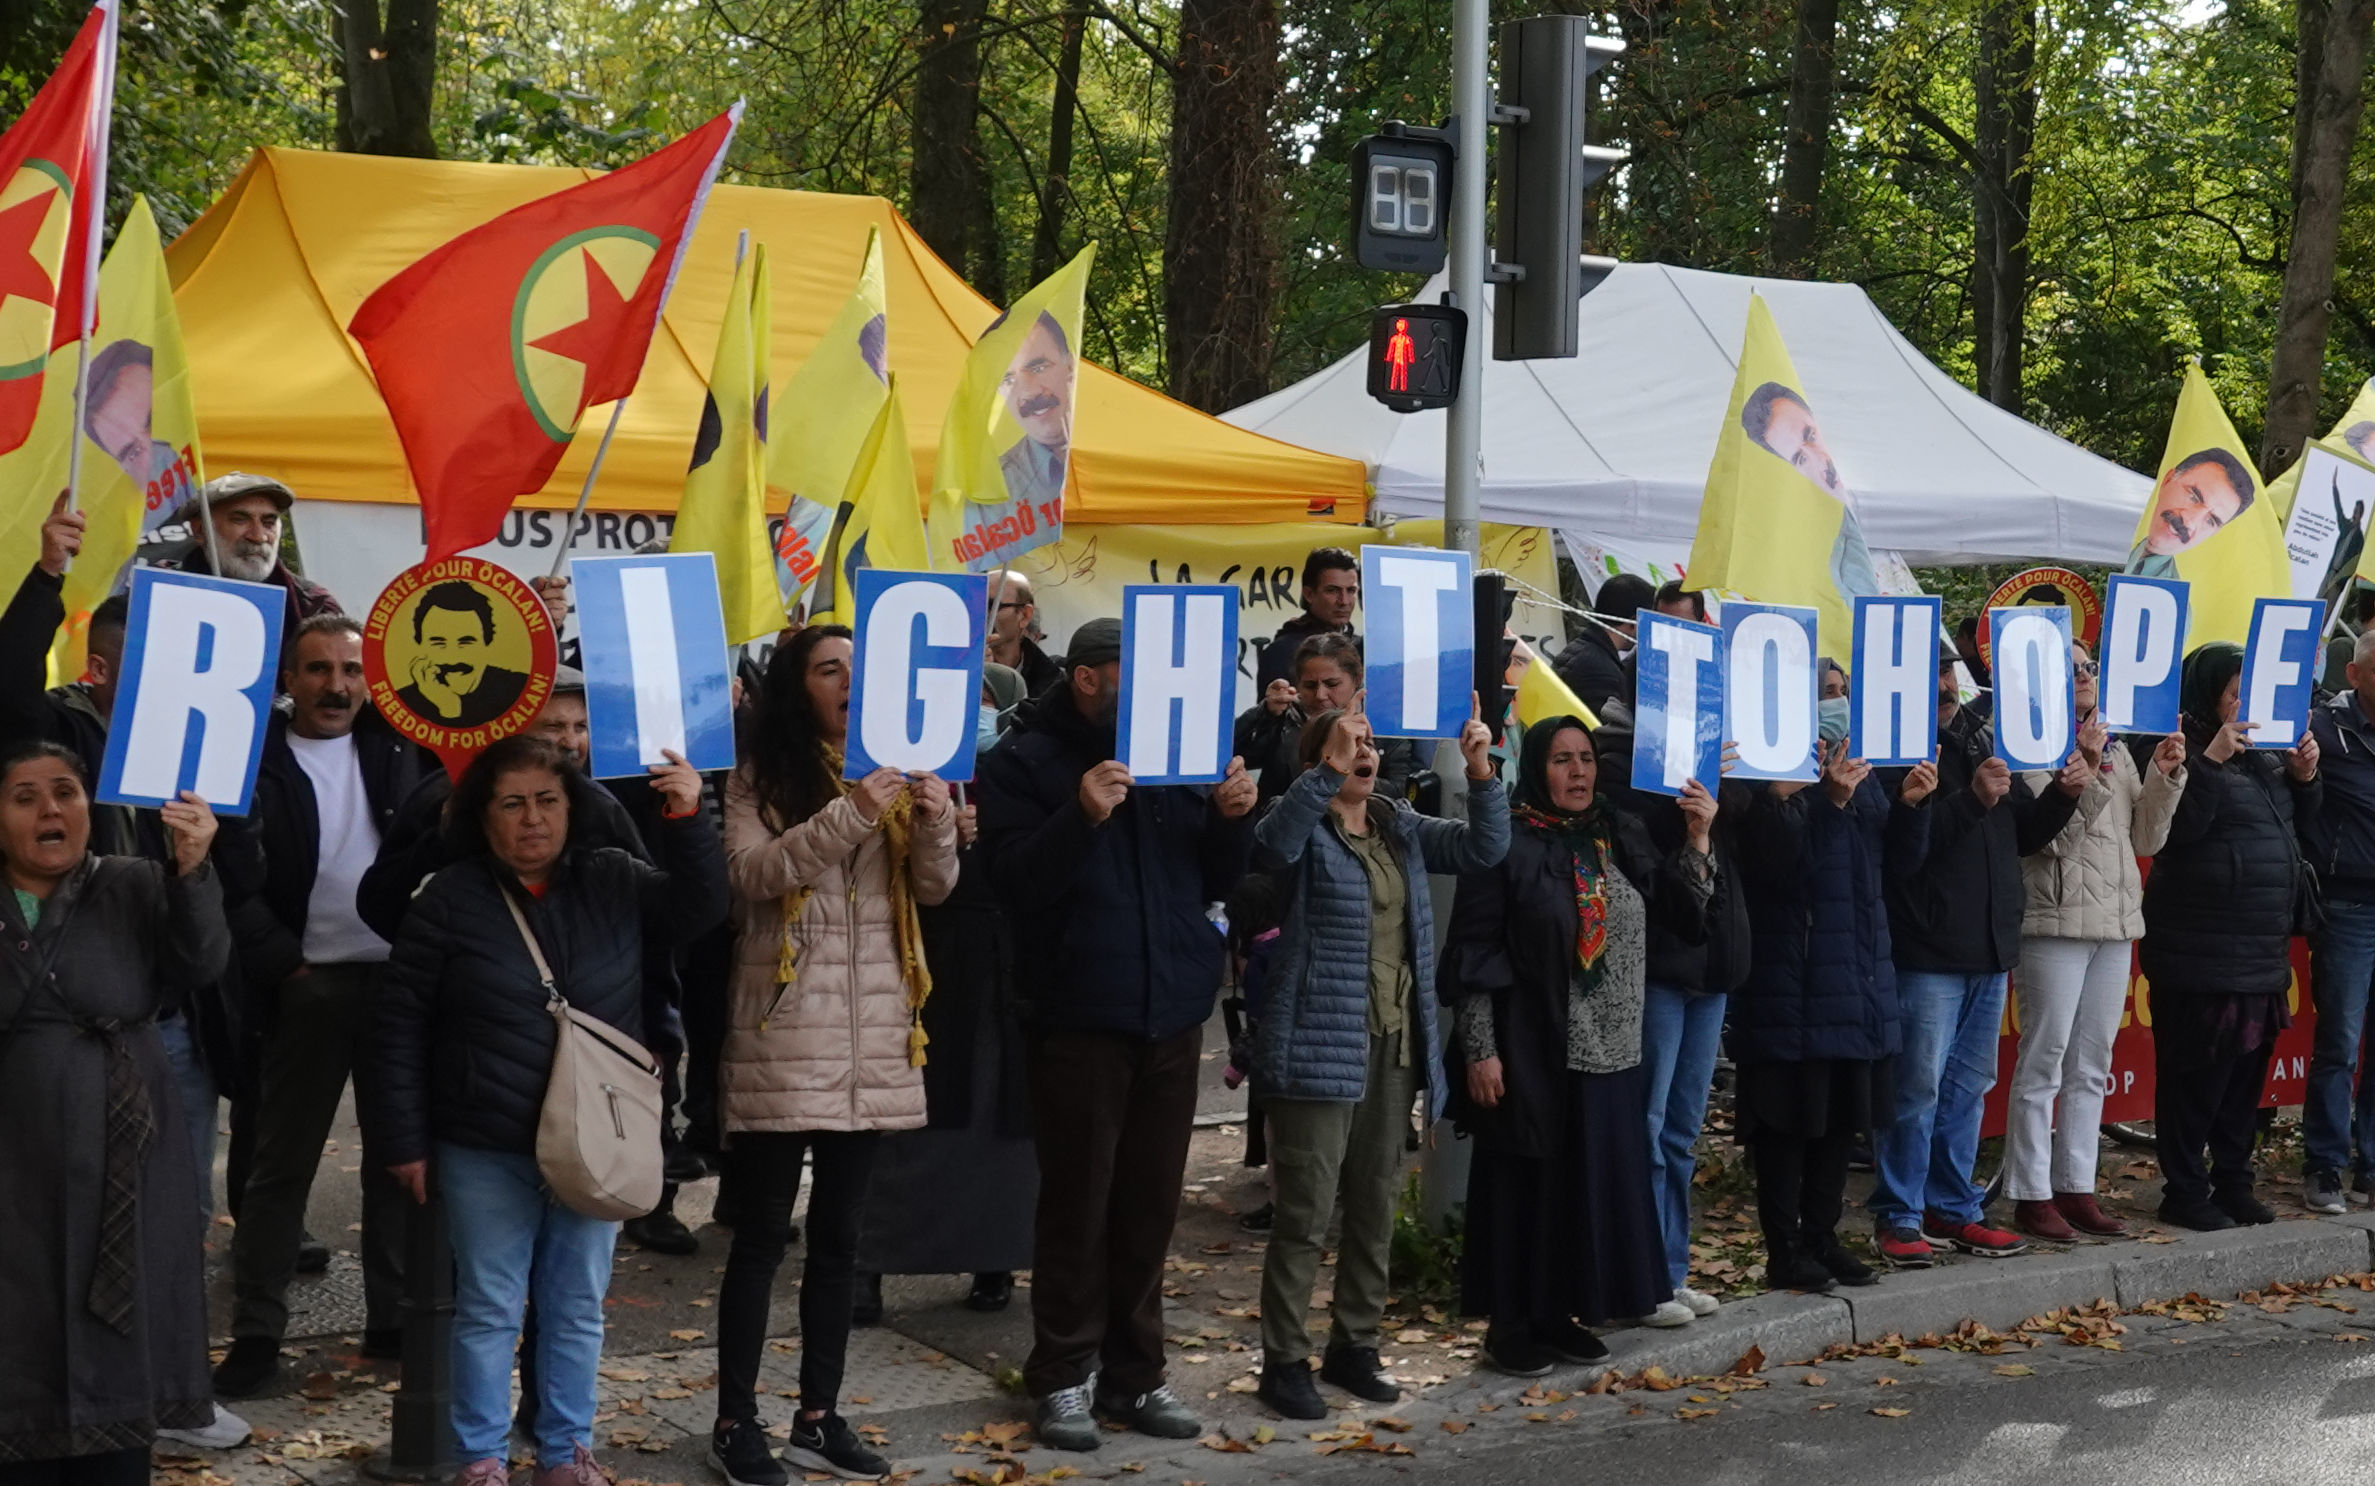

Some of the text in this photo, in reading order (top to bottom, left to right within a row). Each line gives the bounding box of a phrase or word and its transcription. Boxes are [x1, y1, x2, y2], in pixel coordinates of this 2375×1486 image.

[478, 562, 547, 633] ÖCALAN!
[2025, 571, 2060, 584] POUR
[372, 673, 550, 749] FREEDOM FOR ÖCALAN!
